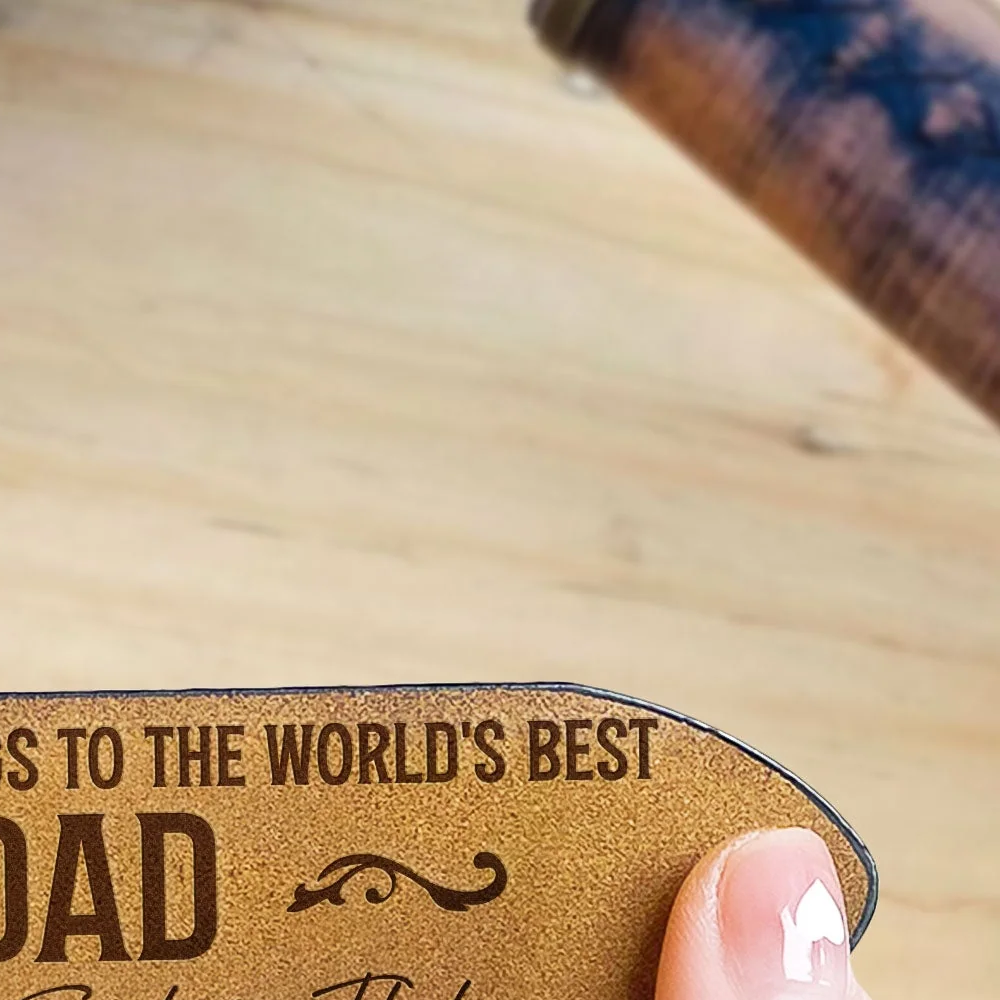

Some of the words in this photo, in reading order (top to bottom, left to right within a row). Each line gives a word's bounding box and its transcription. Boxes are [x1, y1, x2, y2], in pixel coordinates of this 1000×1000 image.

[57, 727, 123, 789] TO
[144, 725, 245, 787] THE
[264, 719, 506, 786] WORLD'S
[528, 718, 657, 781] BEST
